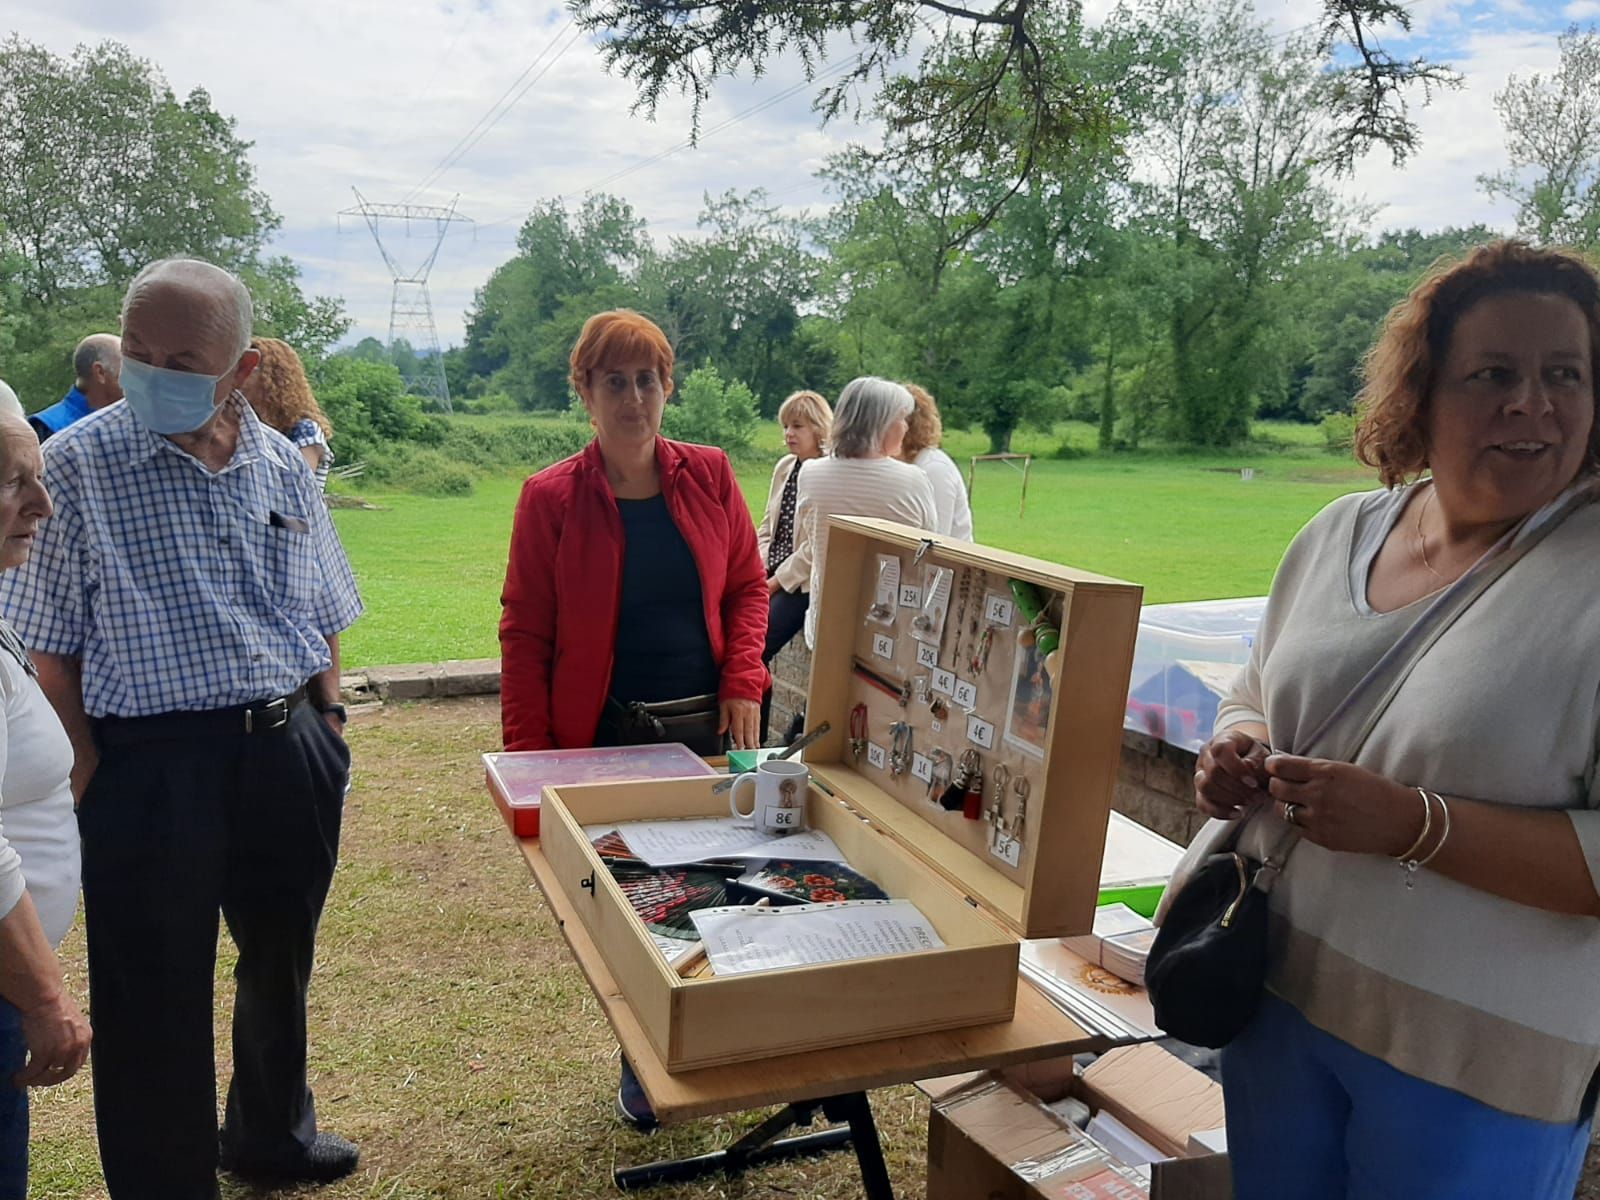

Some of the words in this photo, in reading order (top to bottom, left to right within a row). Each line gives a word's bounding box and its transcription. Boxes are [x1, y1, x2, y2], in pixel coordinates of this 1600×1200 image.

[992, 602, 1006, 619] 5€
[878, 639, 889, 654] 6€
[937, 674, 950, 690] 4€
[957, 686, 970, 702] 6€
[973, 724, 986, 740] 4€
[775, 812, 793, 825] 8€
[998, 839, 1012, 858] 5€
